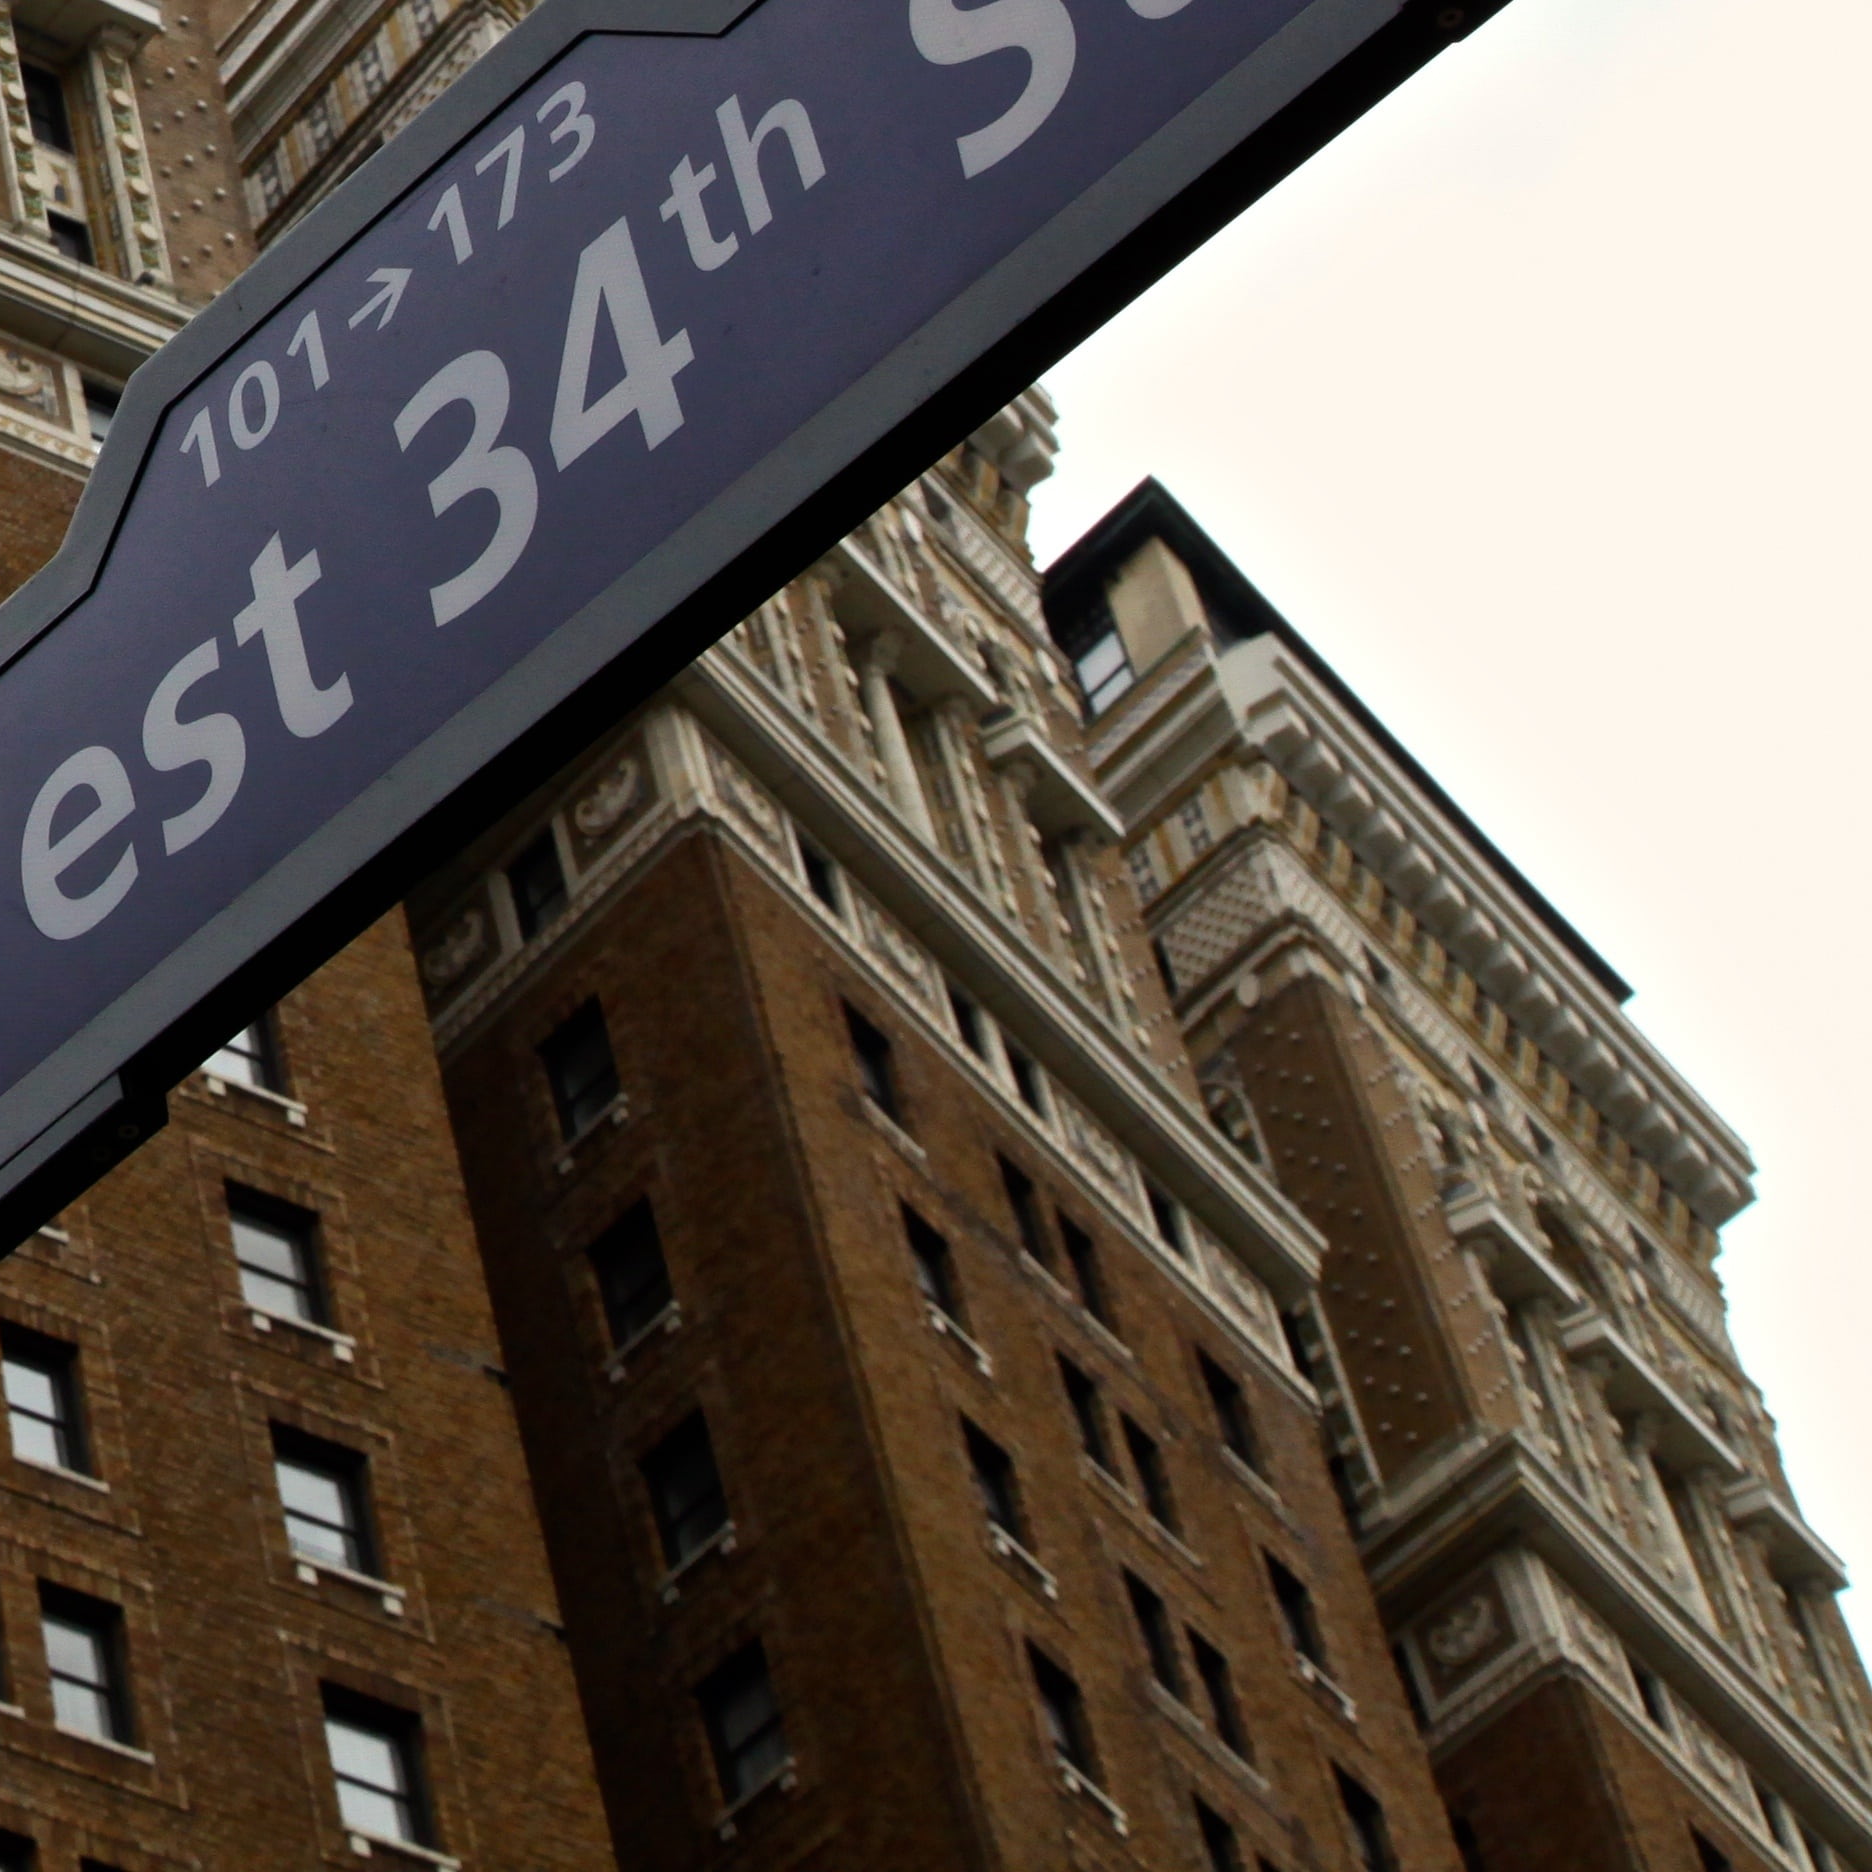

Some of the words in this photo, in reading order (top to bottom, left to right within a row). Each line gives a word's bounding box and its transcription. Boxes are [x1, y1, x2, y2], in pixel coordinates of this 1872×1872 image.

[178, 308, 331, 489] 101
[426, 78, 598, 267] 173
[392, 92, 828, 629] 34th
